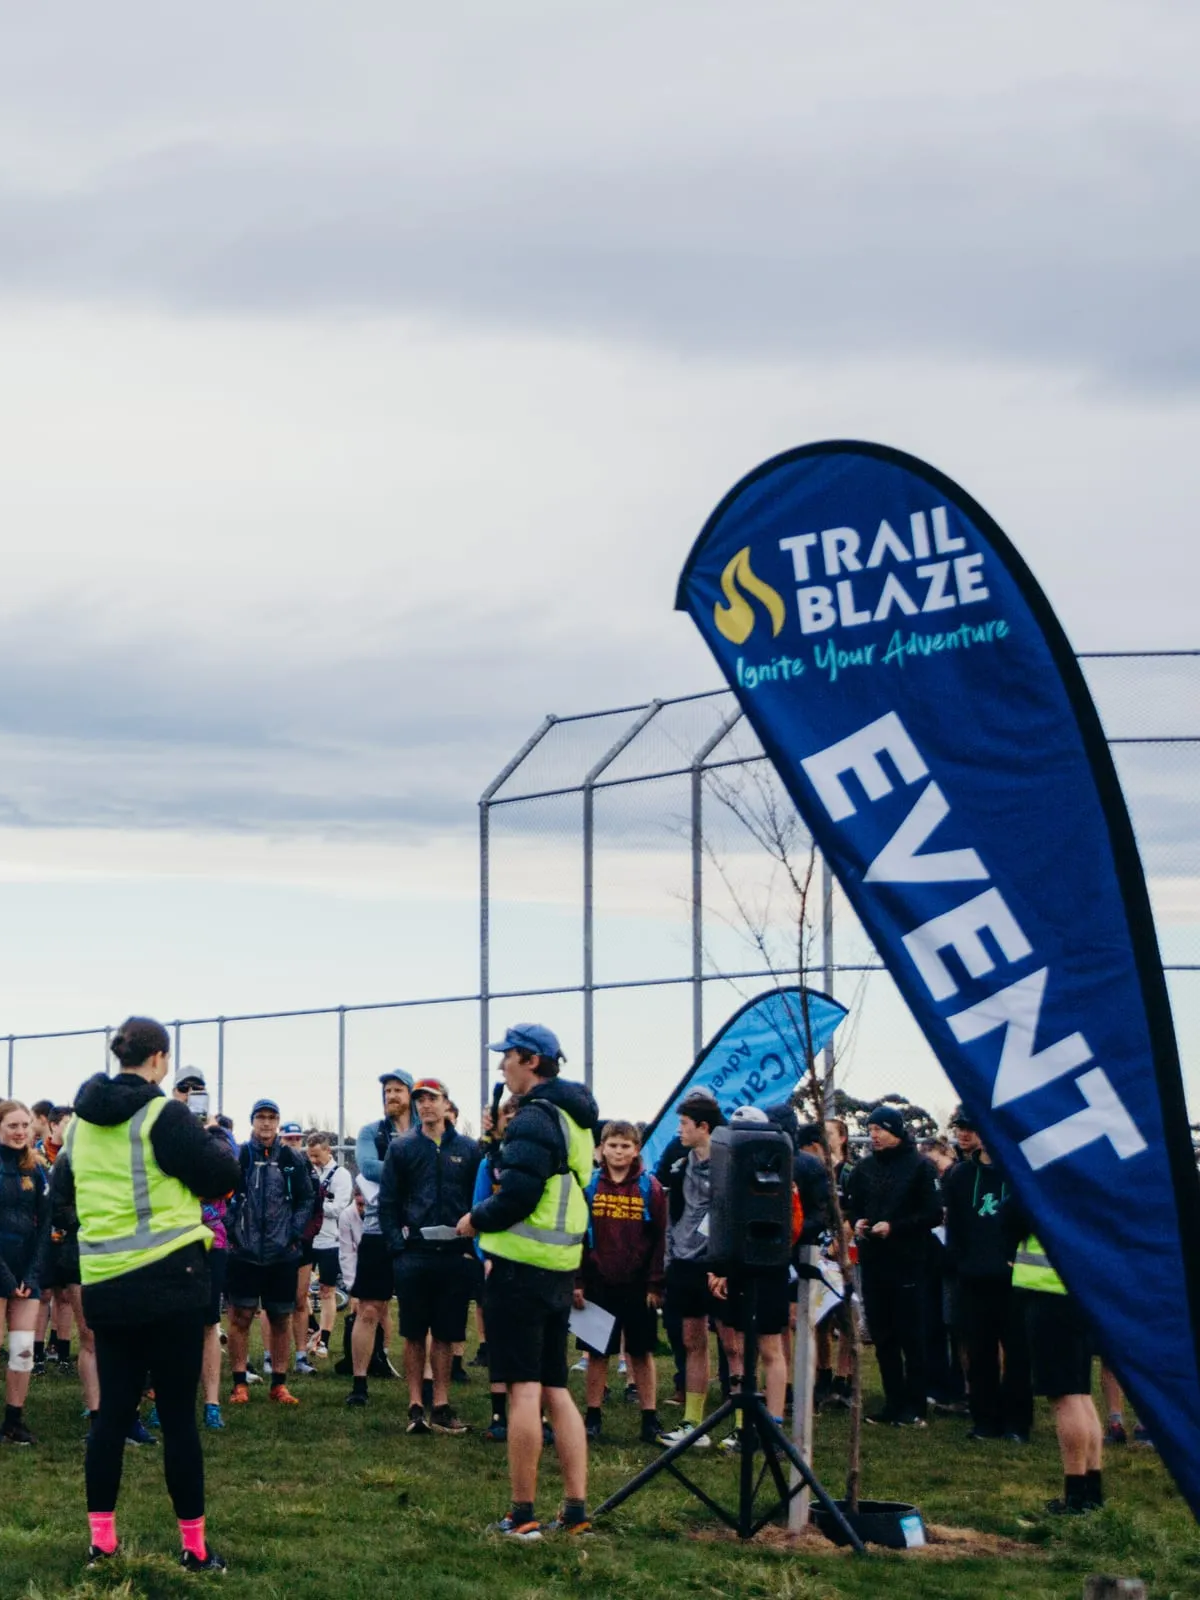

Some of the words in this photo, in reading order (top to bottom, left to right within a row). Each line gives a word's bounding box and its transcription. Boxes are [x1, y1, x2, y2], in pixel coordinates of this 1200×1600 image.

[779, 506, 966, 582] TRAIL
[796, 553, 989, 635] BLAZE
[736, 656, 804, 688] Ignite
[813, 638, 876, 682] Your
[880, 619, 1010, 669] Adventure
[800, 710, 1148, 1171] EVENT
